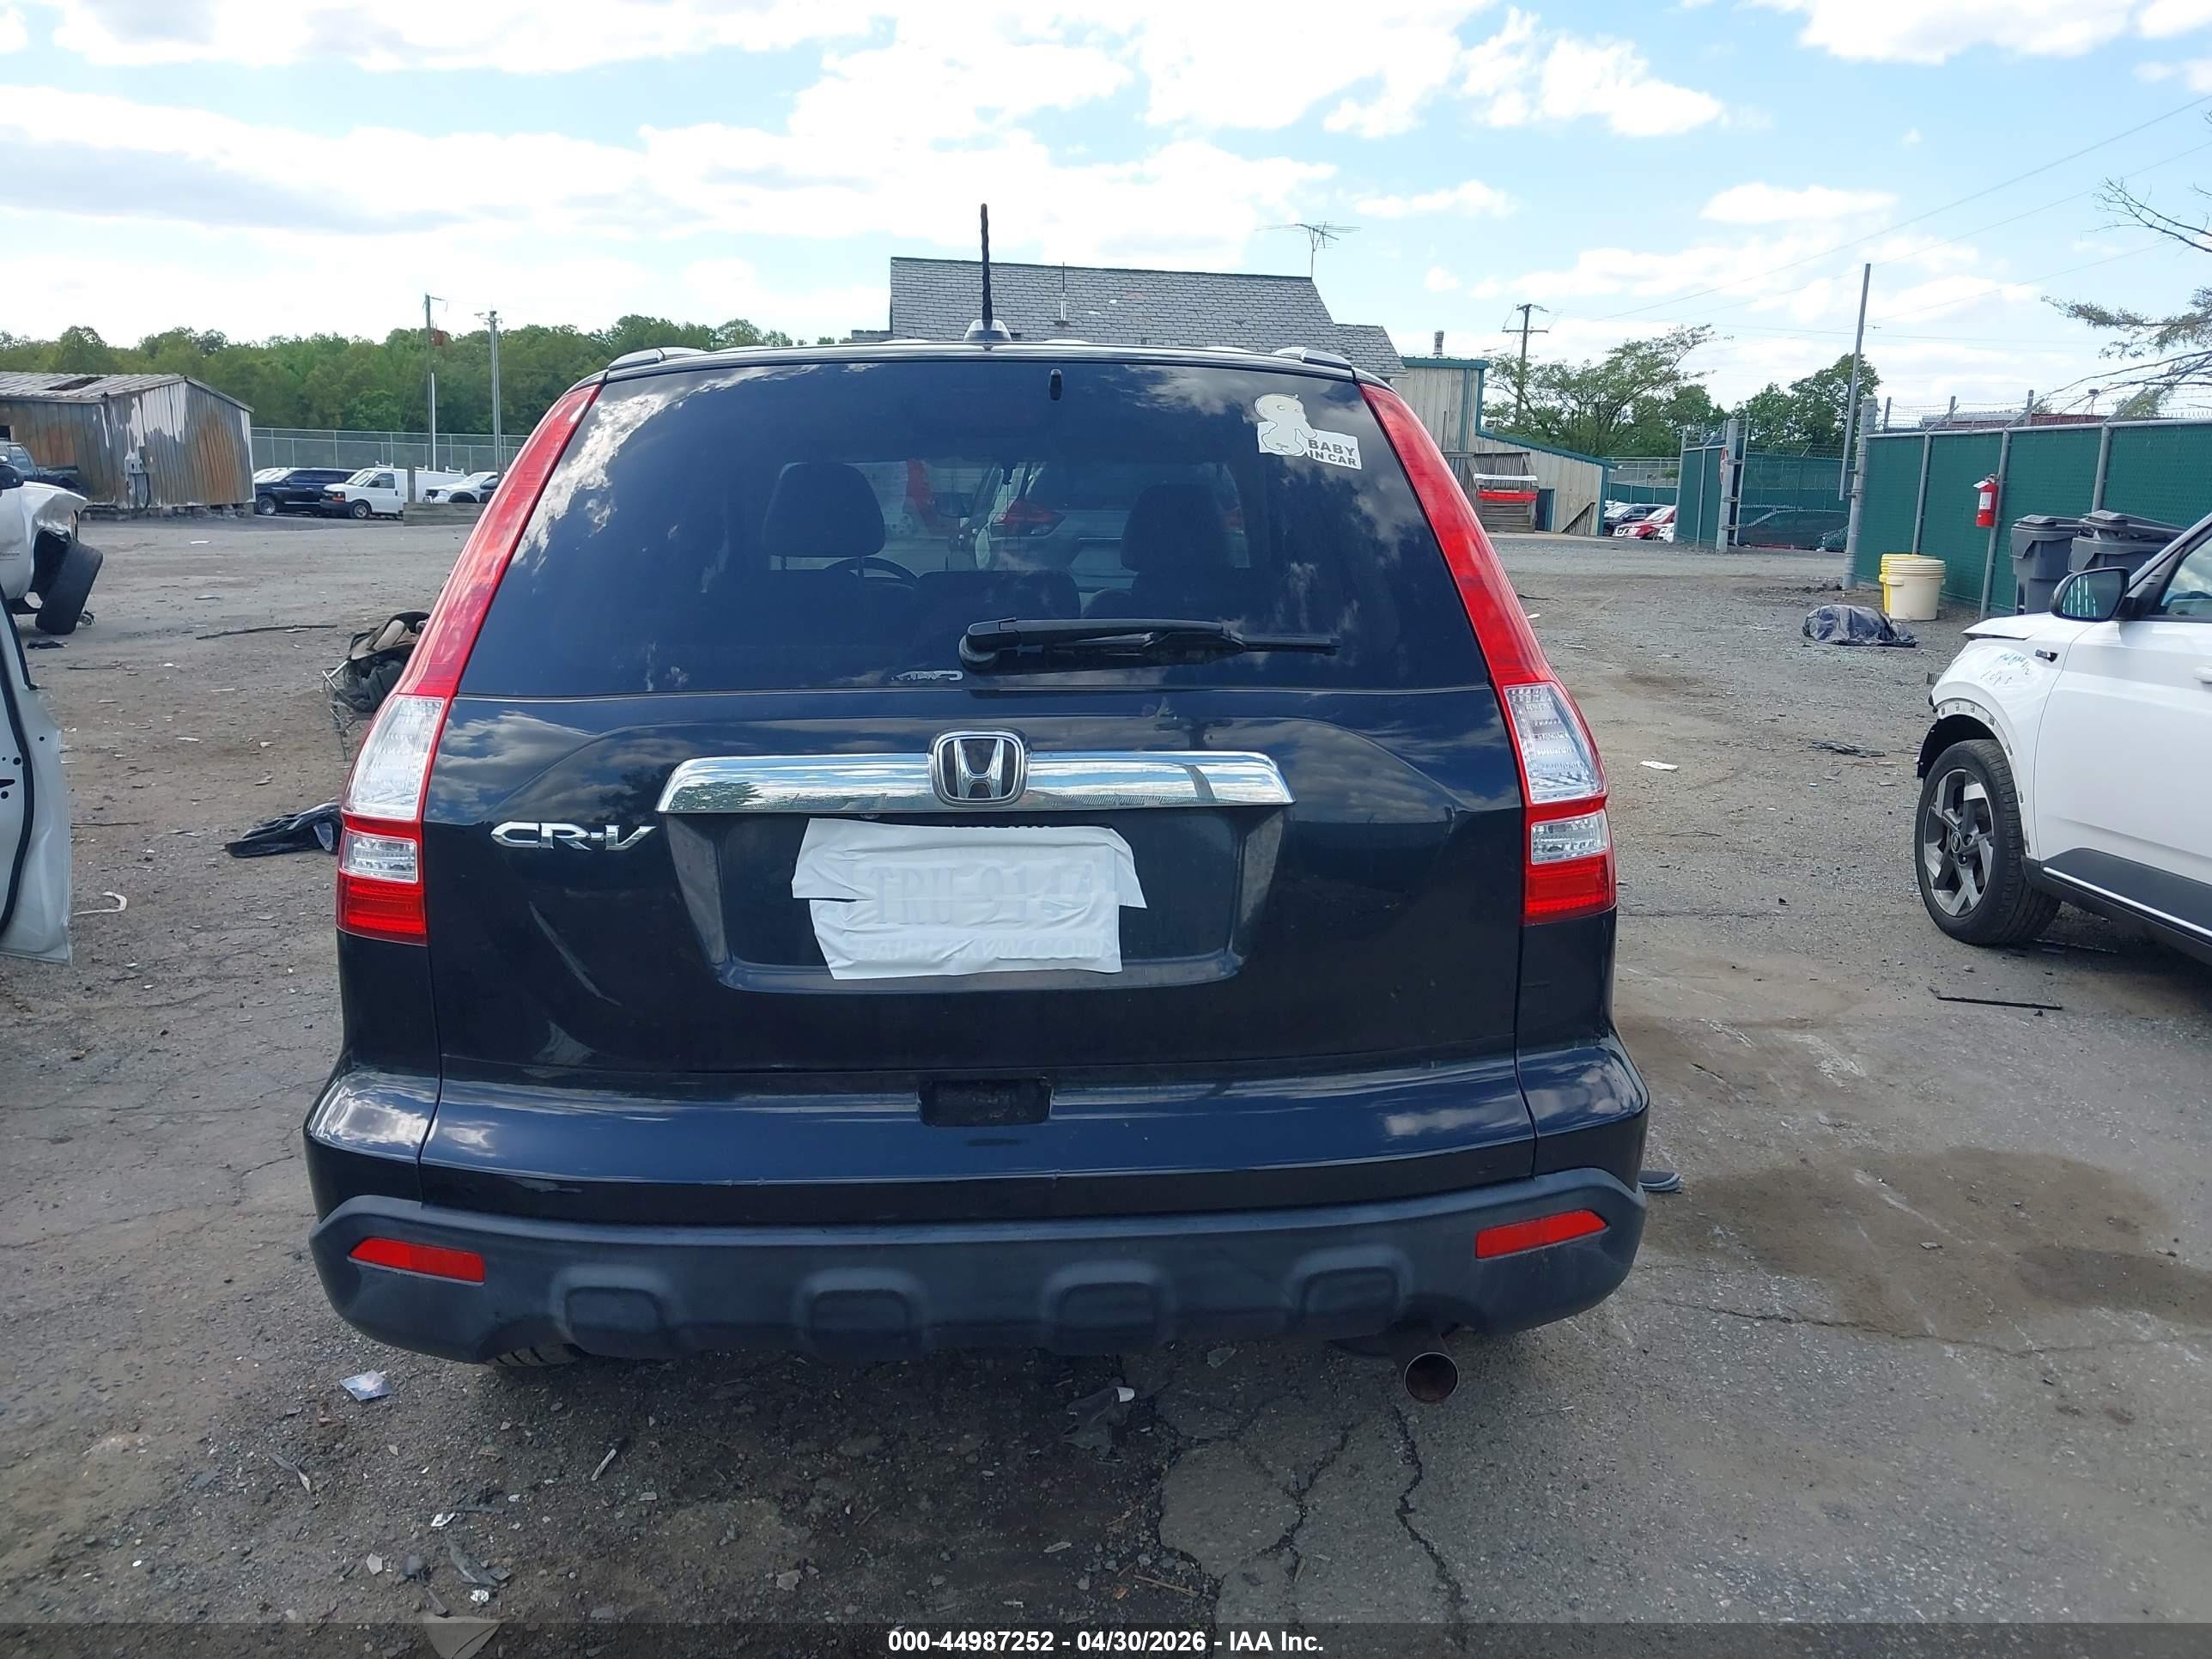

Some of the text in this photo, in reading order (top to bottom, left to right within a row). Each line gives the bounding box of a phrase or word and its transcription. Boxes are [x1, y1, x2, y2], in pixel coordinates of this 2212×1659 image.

[1308, 439, 1355, 457] BABY
[1310, 450, 1358, 466] IN CAR
[490, 821, 657, 851] CR-V
